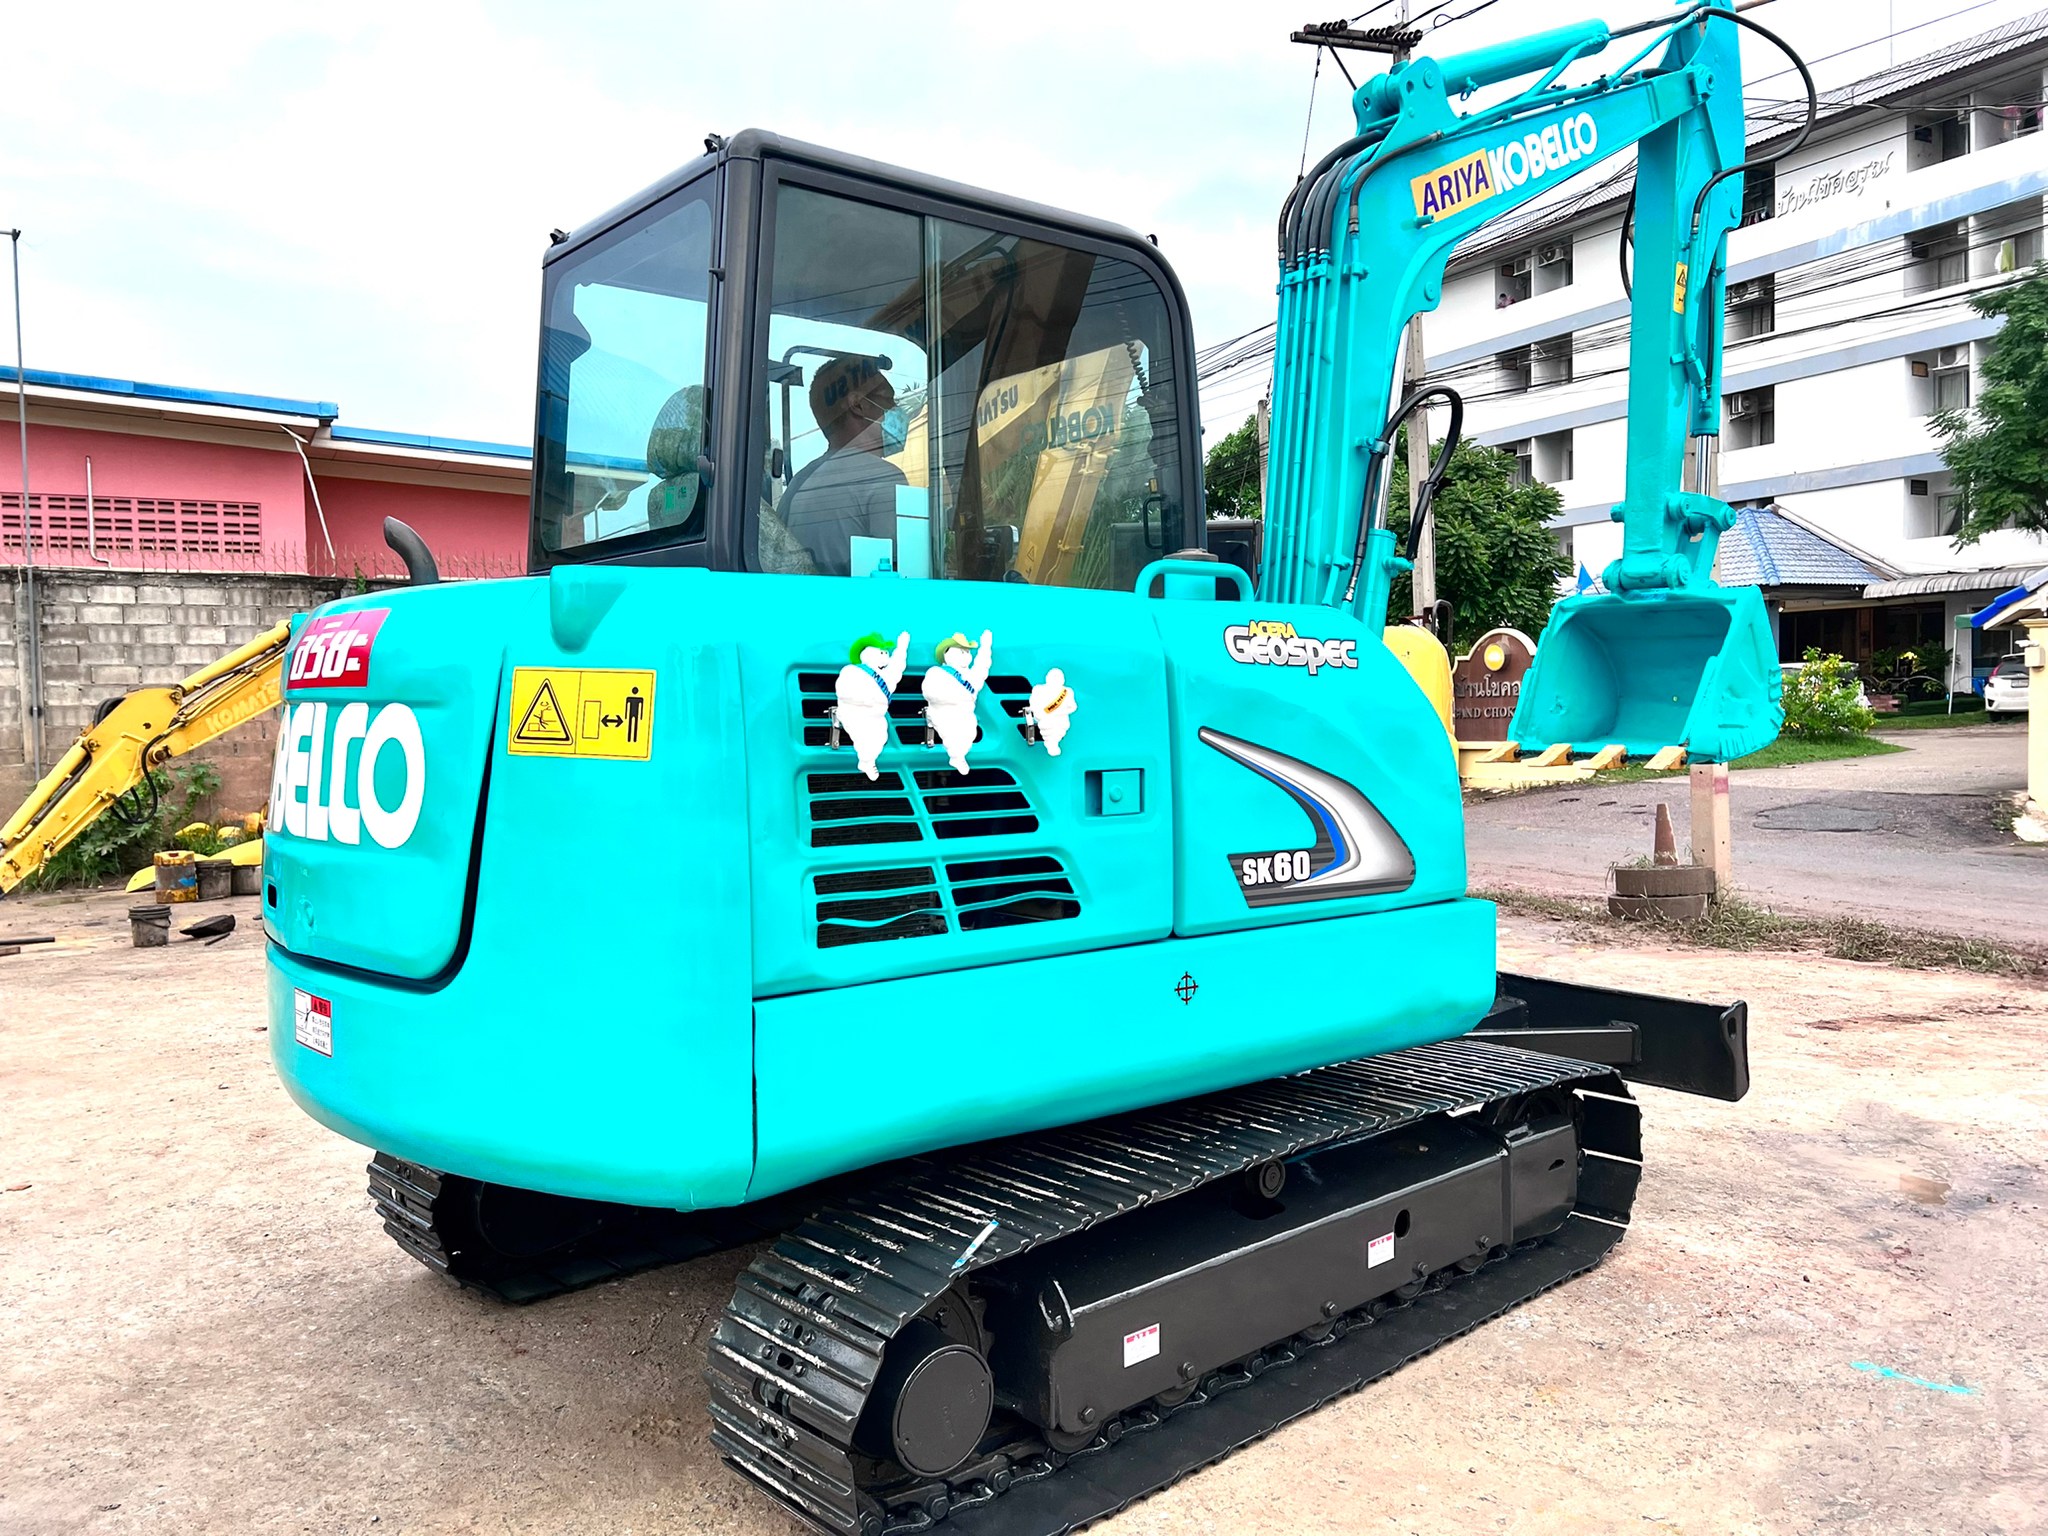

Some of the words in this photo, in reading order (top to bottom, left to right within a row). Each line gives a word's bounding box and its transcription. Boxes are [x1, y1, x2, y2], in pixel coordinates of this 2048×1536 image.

[1422, 158, 1490, 217] ARIYA
[1488, 111, 1598, 196] KOBELCO
[1248, 619, 1299, 639] ACERA
[1241, 850, 1312, 886] SK60
